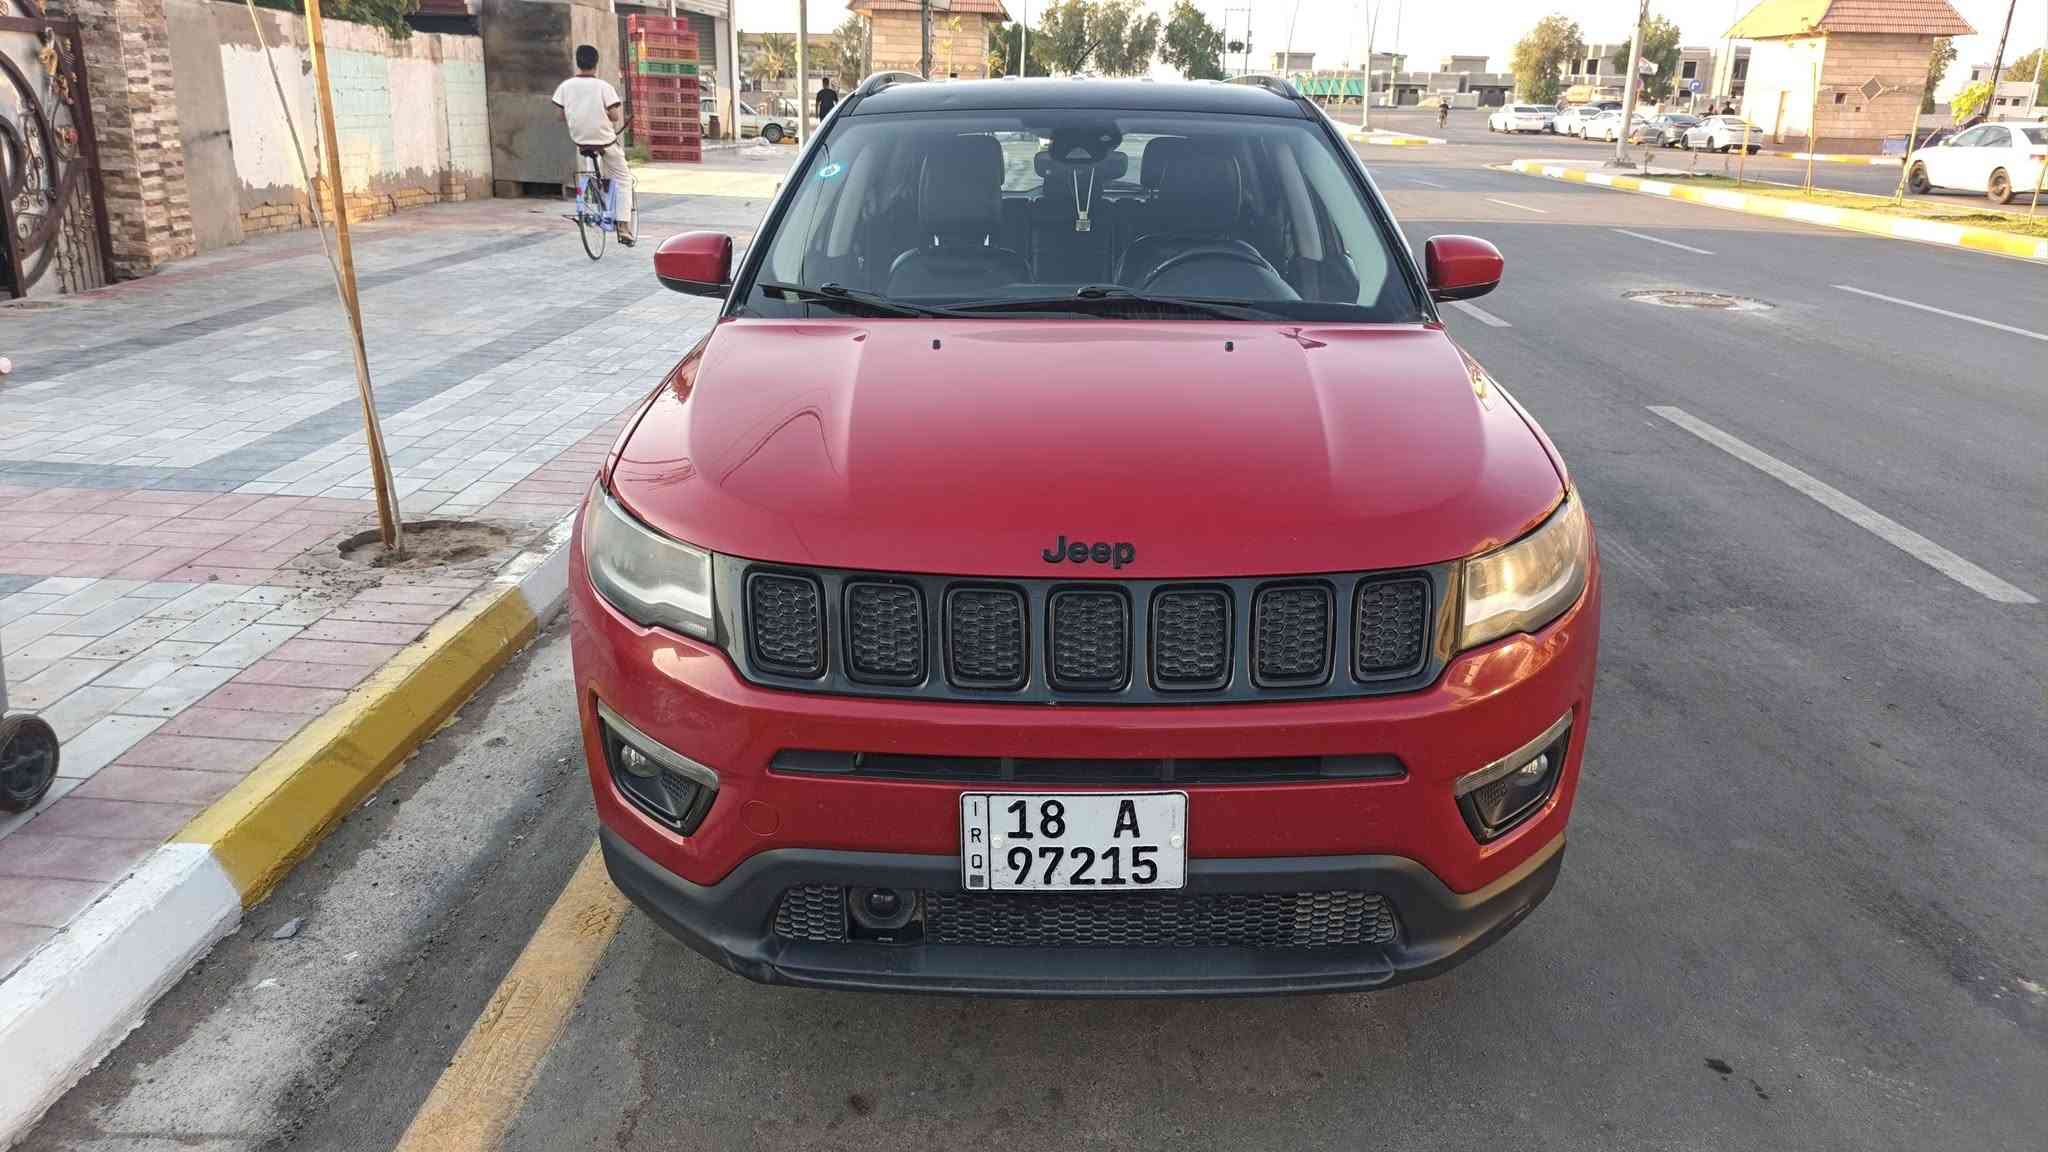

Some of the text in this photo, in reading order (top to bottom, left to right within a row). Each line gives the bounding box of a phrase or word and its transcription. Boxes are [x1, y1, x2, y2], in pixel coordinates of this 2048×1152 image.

[1042, 535, 1136, 570] Jeep
[1007, 799, 1066, 840] 18
[1113, 799, 1141, 839] A
[1007, 846, 1159, 886] 97215
